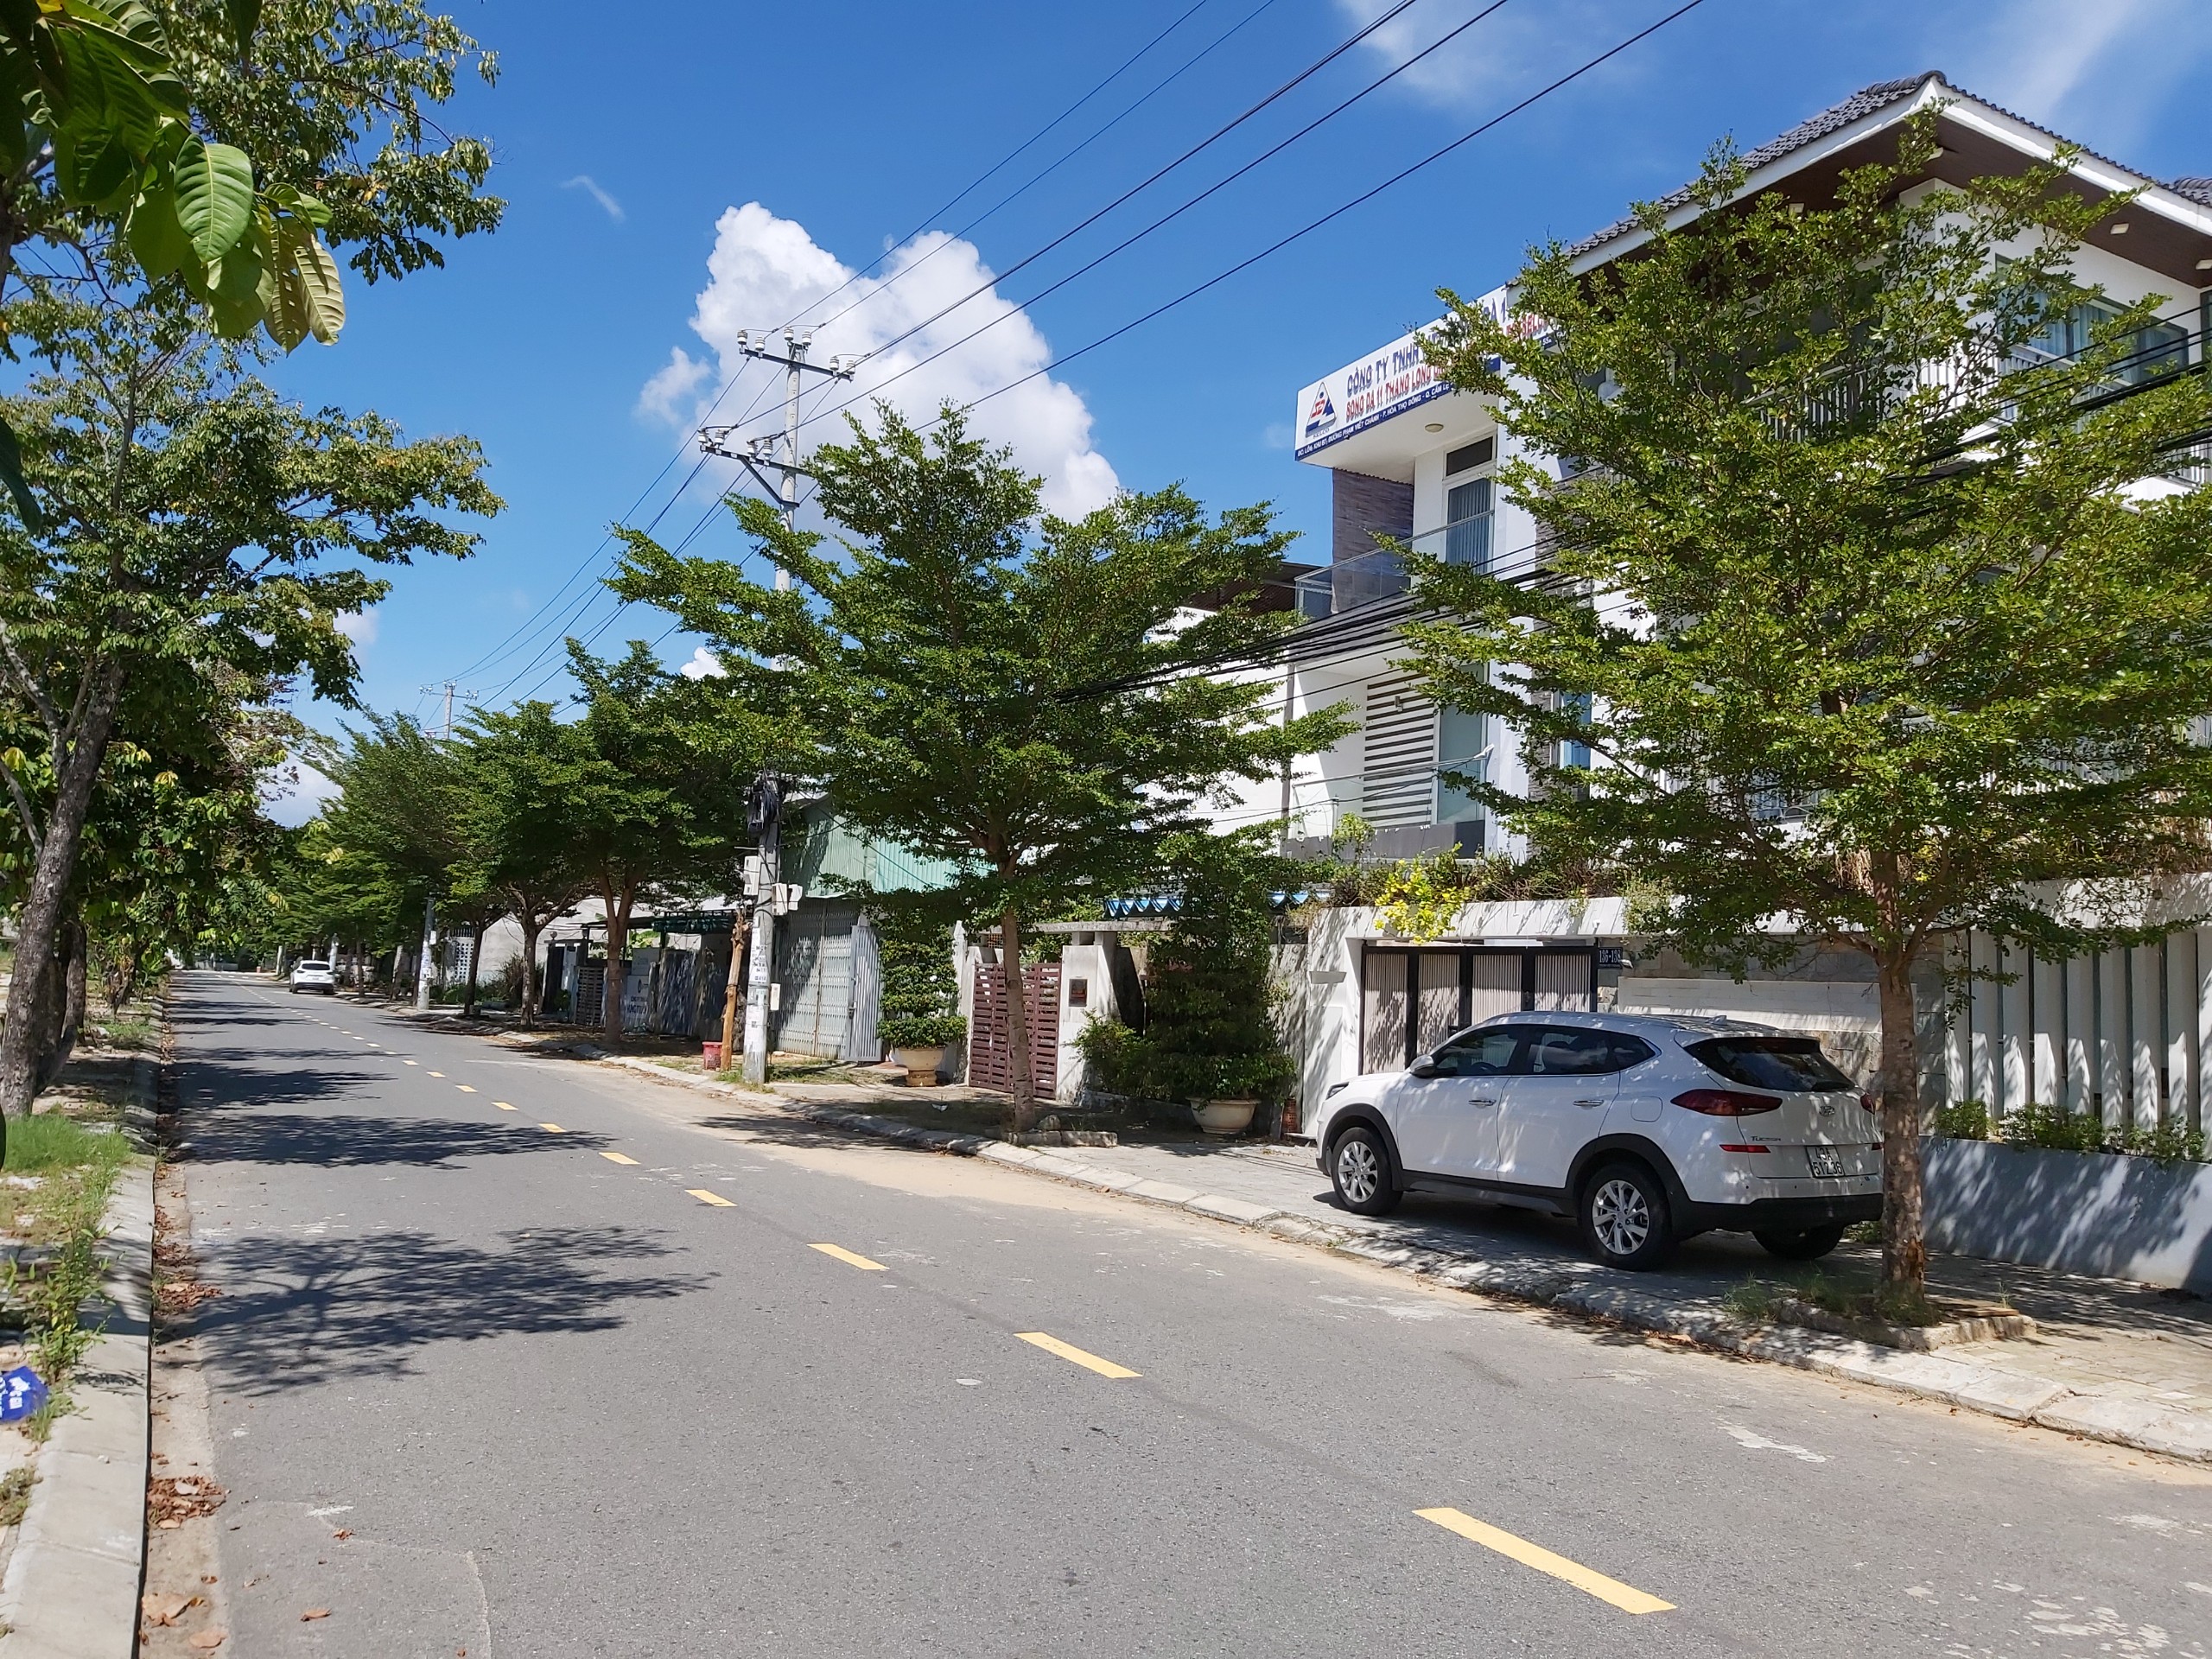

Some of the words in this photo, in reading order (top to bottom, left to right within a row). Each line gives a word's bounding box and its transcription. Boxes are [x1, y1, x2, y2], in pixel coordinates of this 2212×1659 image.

[1347, 365, 1373, 396] CÔNG
[1376, 356, 1389, 382] TY
[1815, 1147, 1834, 1161] 43A
